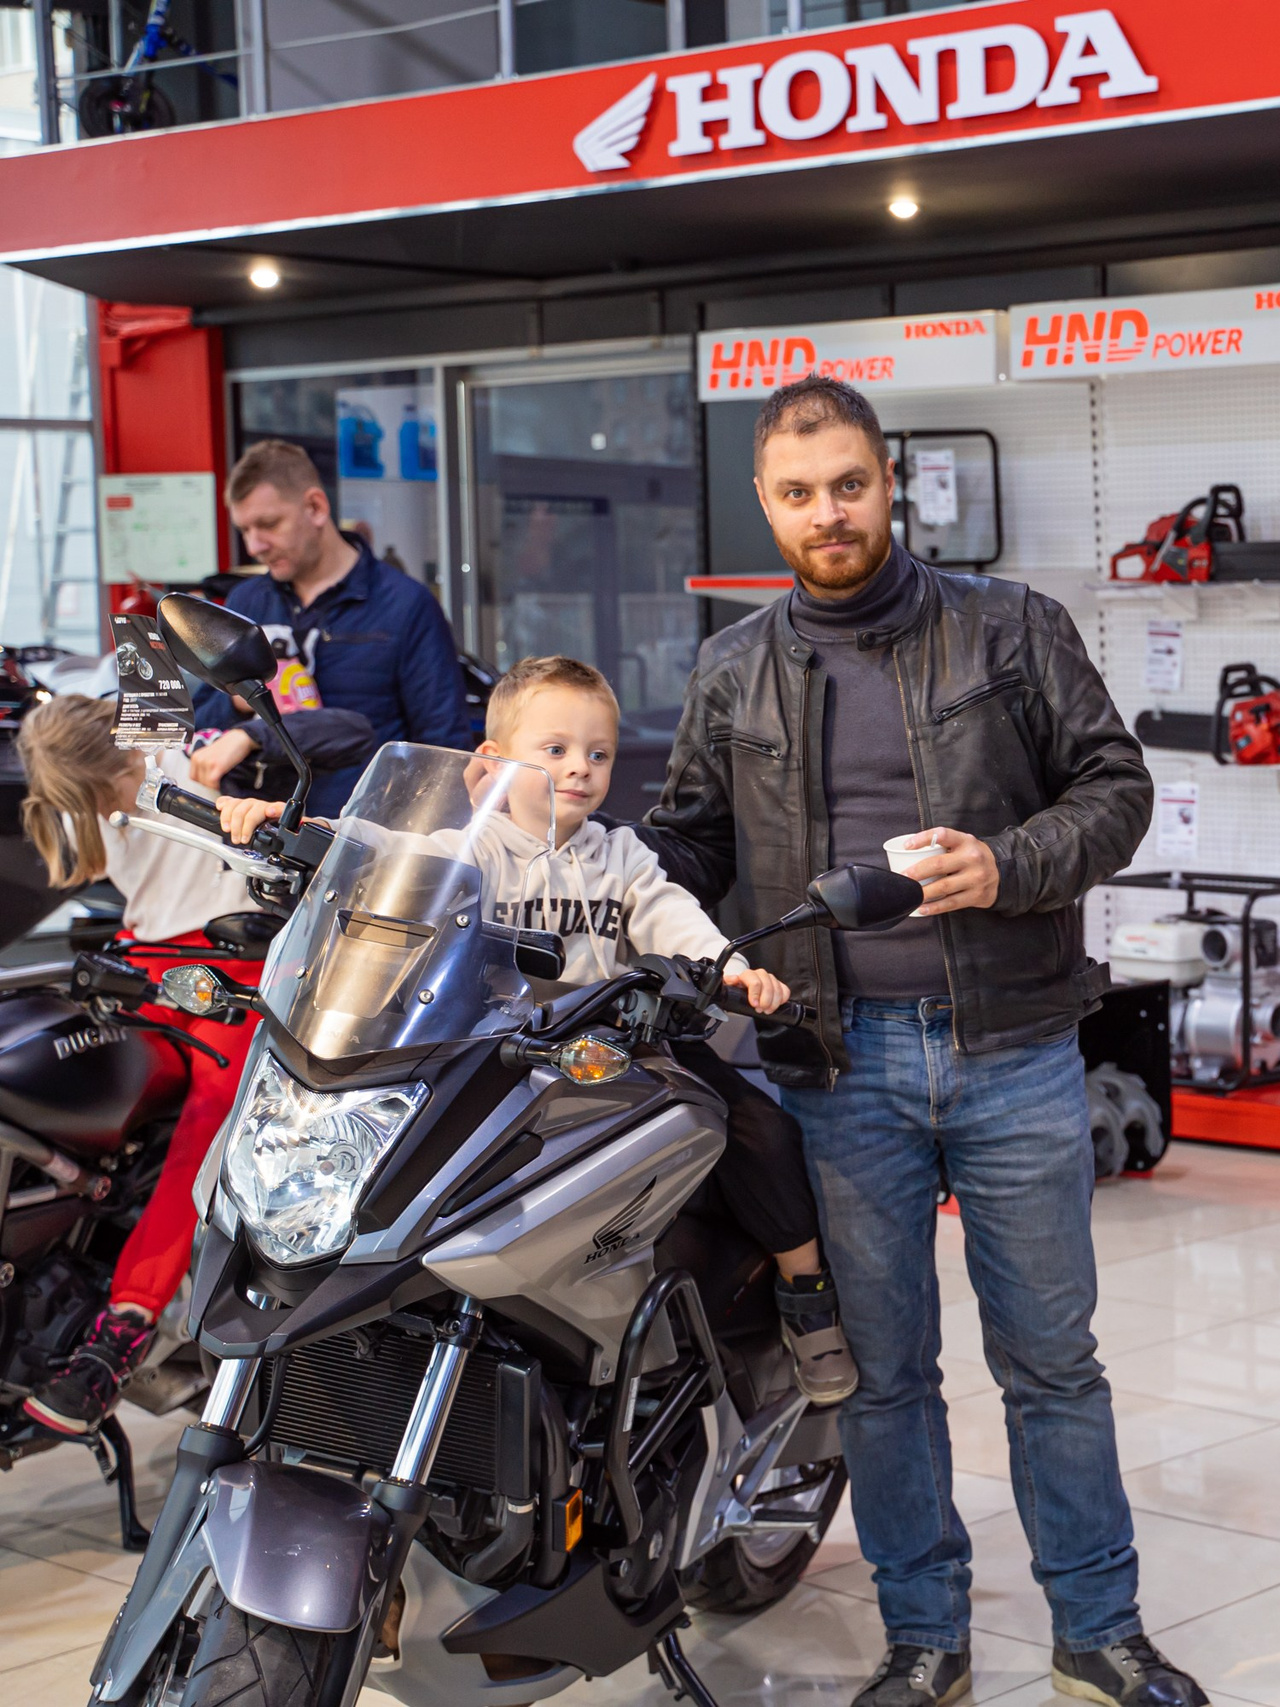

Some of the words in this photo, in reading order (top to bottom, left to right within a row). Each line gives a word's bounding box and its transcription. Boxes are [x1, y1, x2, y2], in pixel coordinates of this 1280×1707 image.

[665, 9, 1158, 157] HONDA
[904, 319, 987, 340] HONDA
[1021, 309, 1150, 367] HND
[1152, 328, 1243, 359] POWER
[708, 337, 816, 390] HND
[819, 356, 895, 382] POWER
